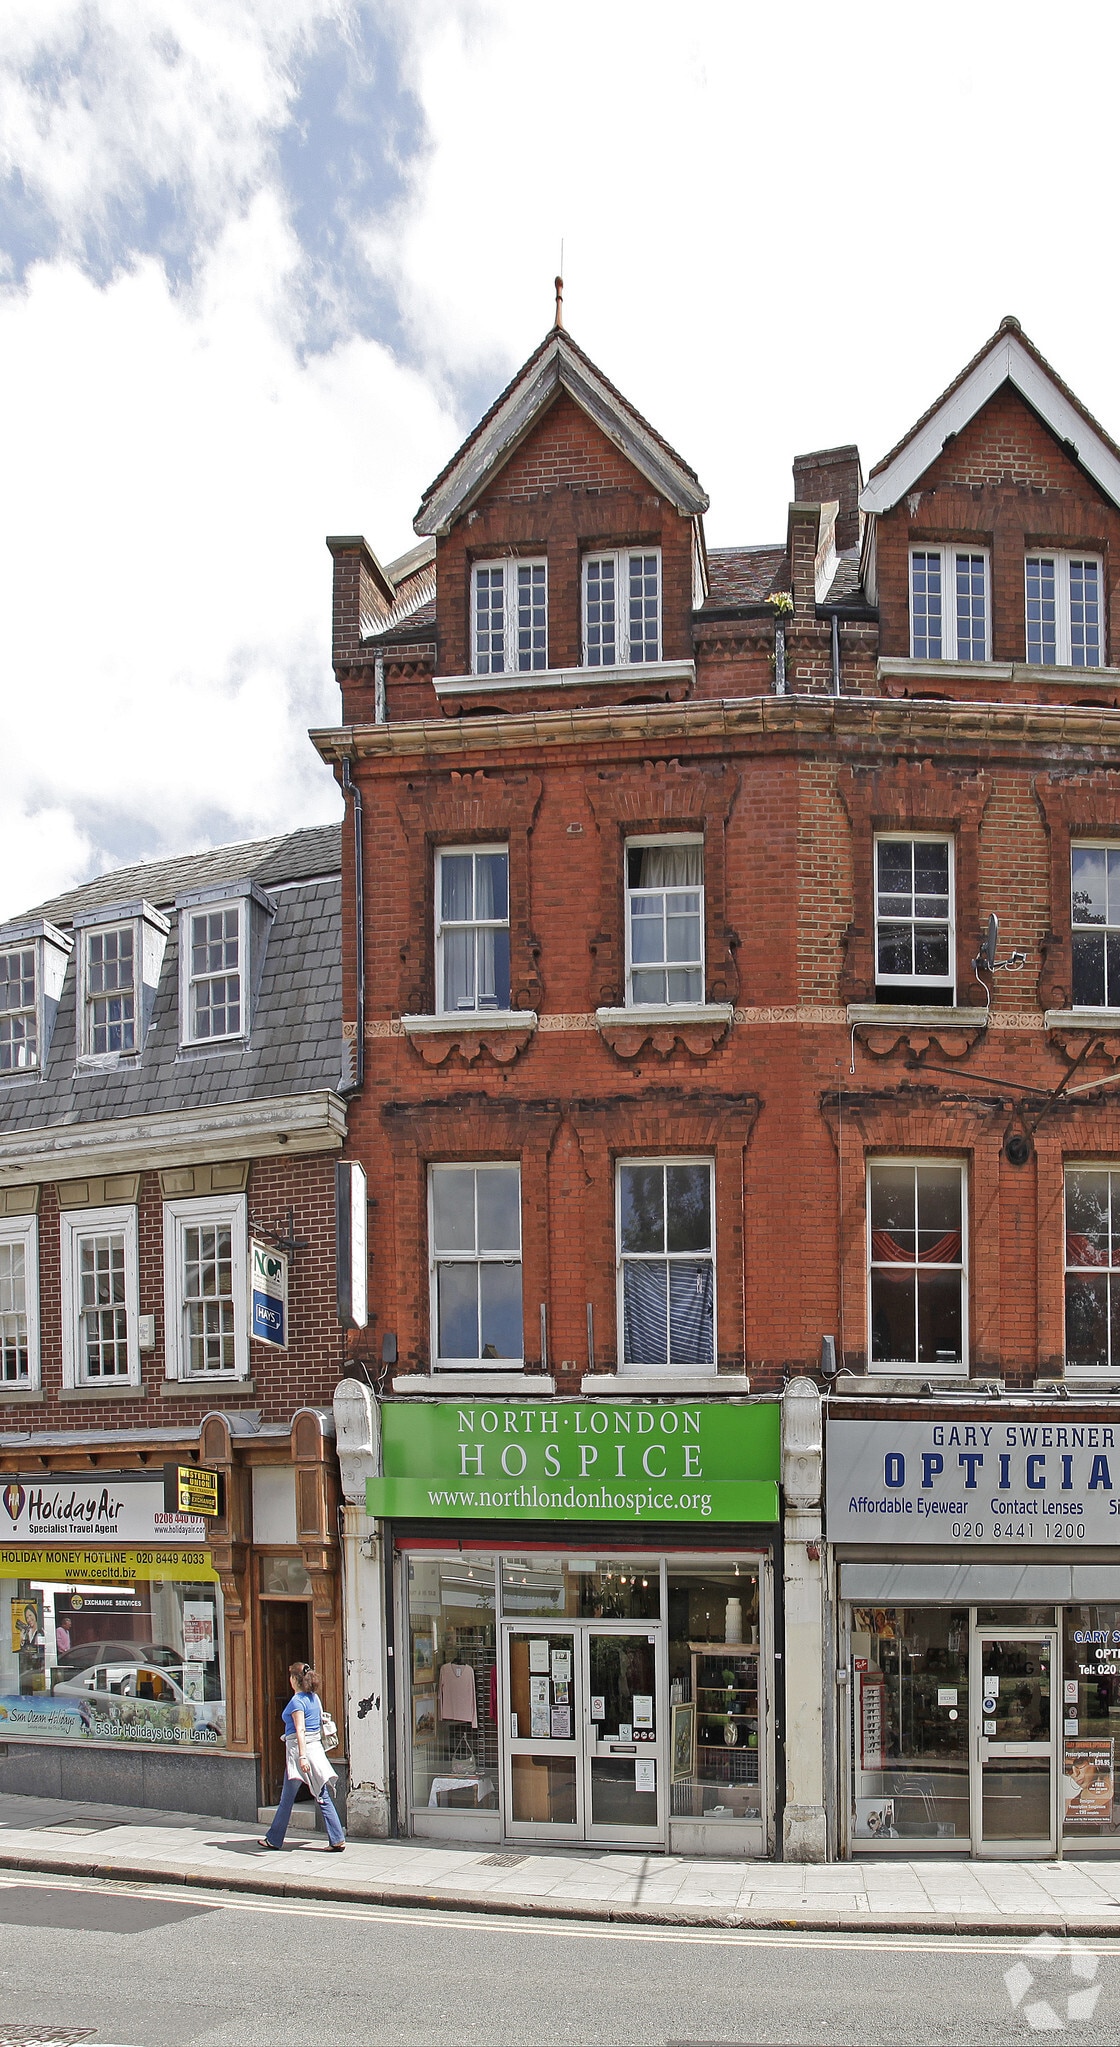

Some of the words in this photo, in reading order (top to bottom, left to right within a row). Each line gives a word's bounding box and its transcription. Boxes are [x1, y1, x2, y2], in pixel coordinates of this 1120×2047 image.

[258, 1307, 276, 1323] HAYS
[933, 1426, 993, 1447] GARY
[1006, 1427, 1115, 1448] SWERNER
[458, 1444, 704, 1478] HOSPICE
[180, 1470, 210, 1481] WESTERN
[883, 1452, 1113, 1490] OPTICIA
[190, 1478, 210, 1487] UNION
[192, 1496, 215, 1506] EXCHANGE
[427, 1486, 712, 1515] www.northlondonhospice.org
[849, 1497, 912, 1514] Affordable
[917, 1498, 968, 1518] Eyewear
[990, 1498, 1038, 1515] Contact
[1042, 1499, 1084, 1516] Lenses
[154, 1513, 173, 1524] 0208
[29, 1524, 67, 1534] Specialist
[69, 1524, 93, 1533] Travel
[95, 1524, 118, 1534] Agent
[952, 1522, 984, 1538] 020
[994, 1523, 1035, 1538] 8441
[1045, 1524, 1086, 1538] 1200
[1, 1552, 43, 1563] HOLIDAY
[46, 1552, 81, 1563] MONEY
[84, 1552, 127, 1563] HOTLINE
[136, 1553, 153, 1564] 020
[156, 1553, 179, 1564] 8449
[181, 1554, 205, 1564] 4033
[65, 1567, 136, 1578] www.cecltd.biz
[1074, 1630, 1109, 1643] GARY
[1079, 1664, 1095, 1674] Tel:
[1098, 1664, 1116, 1674] 020
[10, 1708, 26, 1722] Sun
[28, 1710, 46, 1723] Ocean
[48, 1709, 76, 1734] Holidays
[96, 1723, 121, 1735] 5-Star
[124, 1725, 161, 1741] Holidays
[164, 1729, 173, 1738] to
[174, 1728, 187, 1740] Sri
[189, 1730, 217, 1741] Lanka
